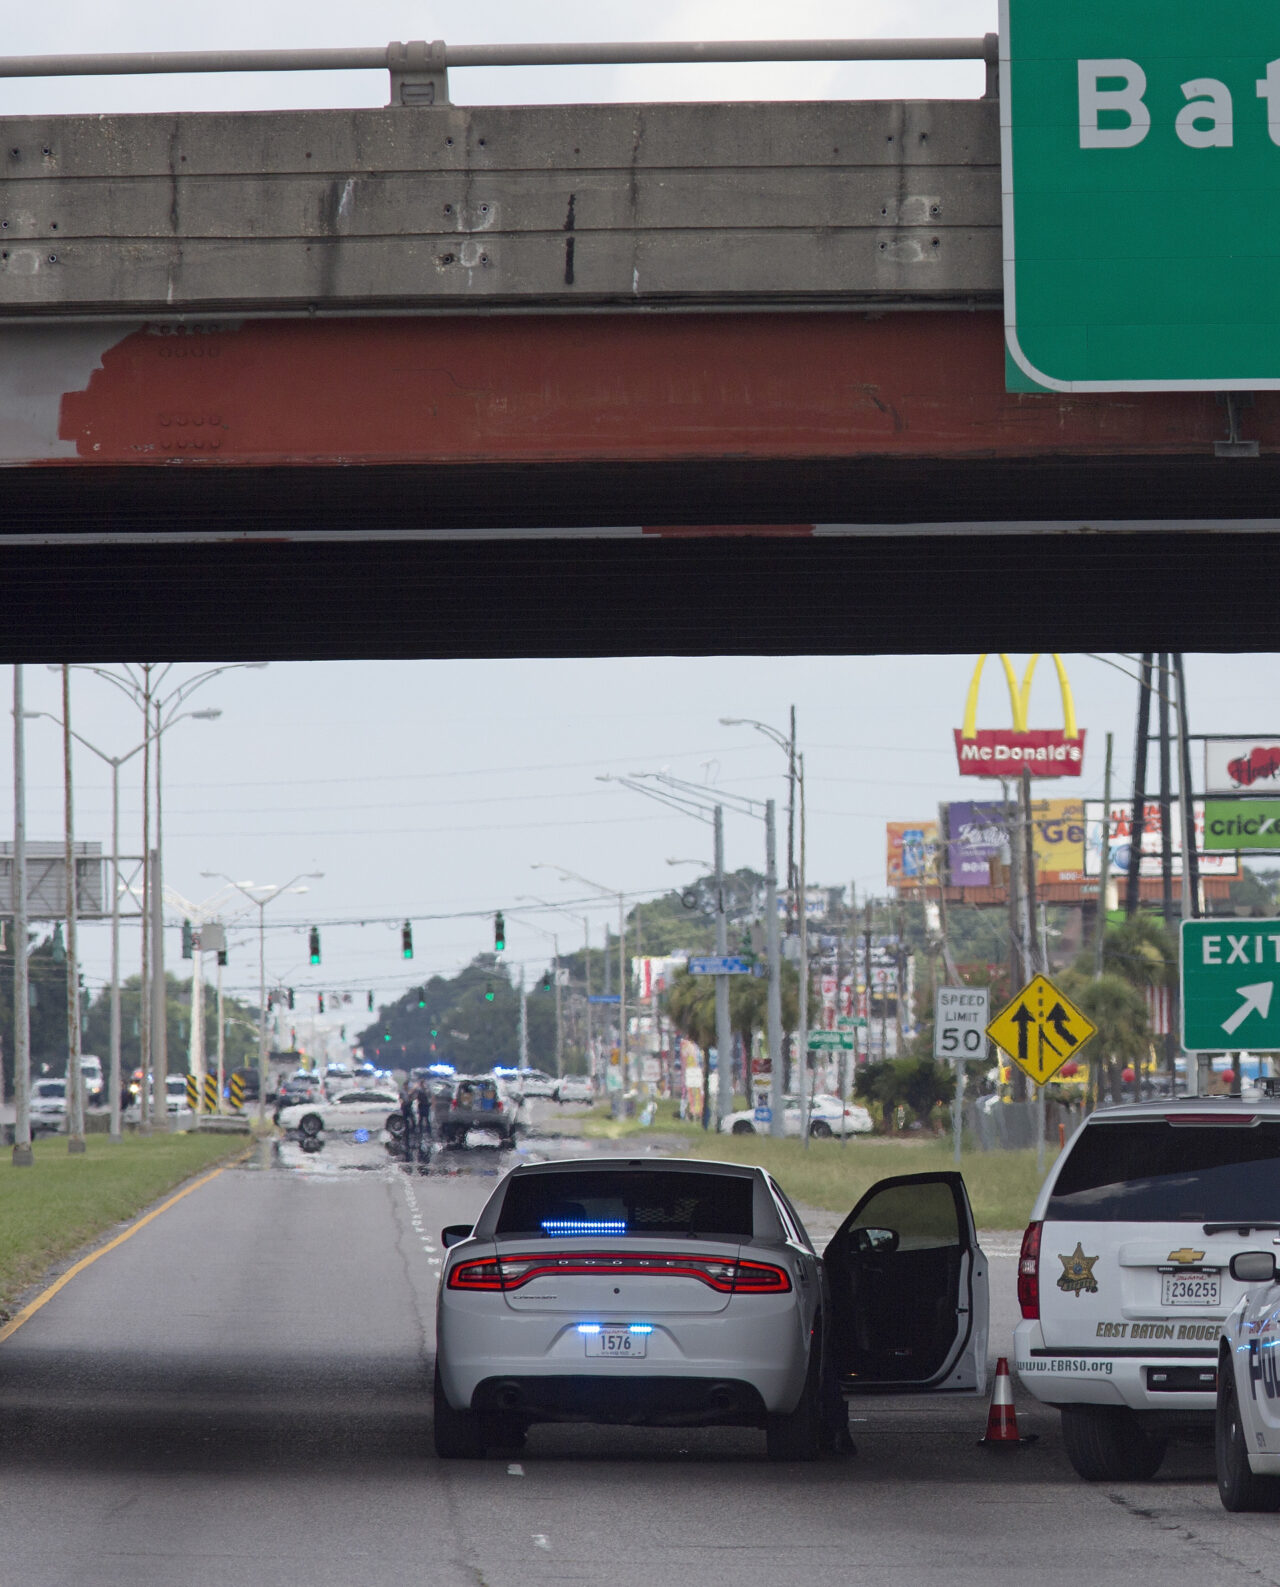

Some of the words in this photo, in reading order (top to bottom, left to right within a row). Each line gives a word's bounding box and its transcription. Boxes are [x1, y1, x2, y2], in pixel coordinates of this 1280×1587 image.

[961, 743, 1082, 762] McDonald's
[941, 993, 985, 1007] SPEED
[945, 1010, 979, 1023] LIMIT
[941, 1027, 982, 1052] 50
[1171, 1282, 1217, 1298] 236255
[1096, 1321, 1128, 1338] EAST
[1130, 1323, 1175, 1340] BATON
[1176, 1324, 1222, 1341] ROUGE
[601, 1335, 632, 1351] 1576
[1016, 1359, 1113, 1375] www.EBRSO.org
